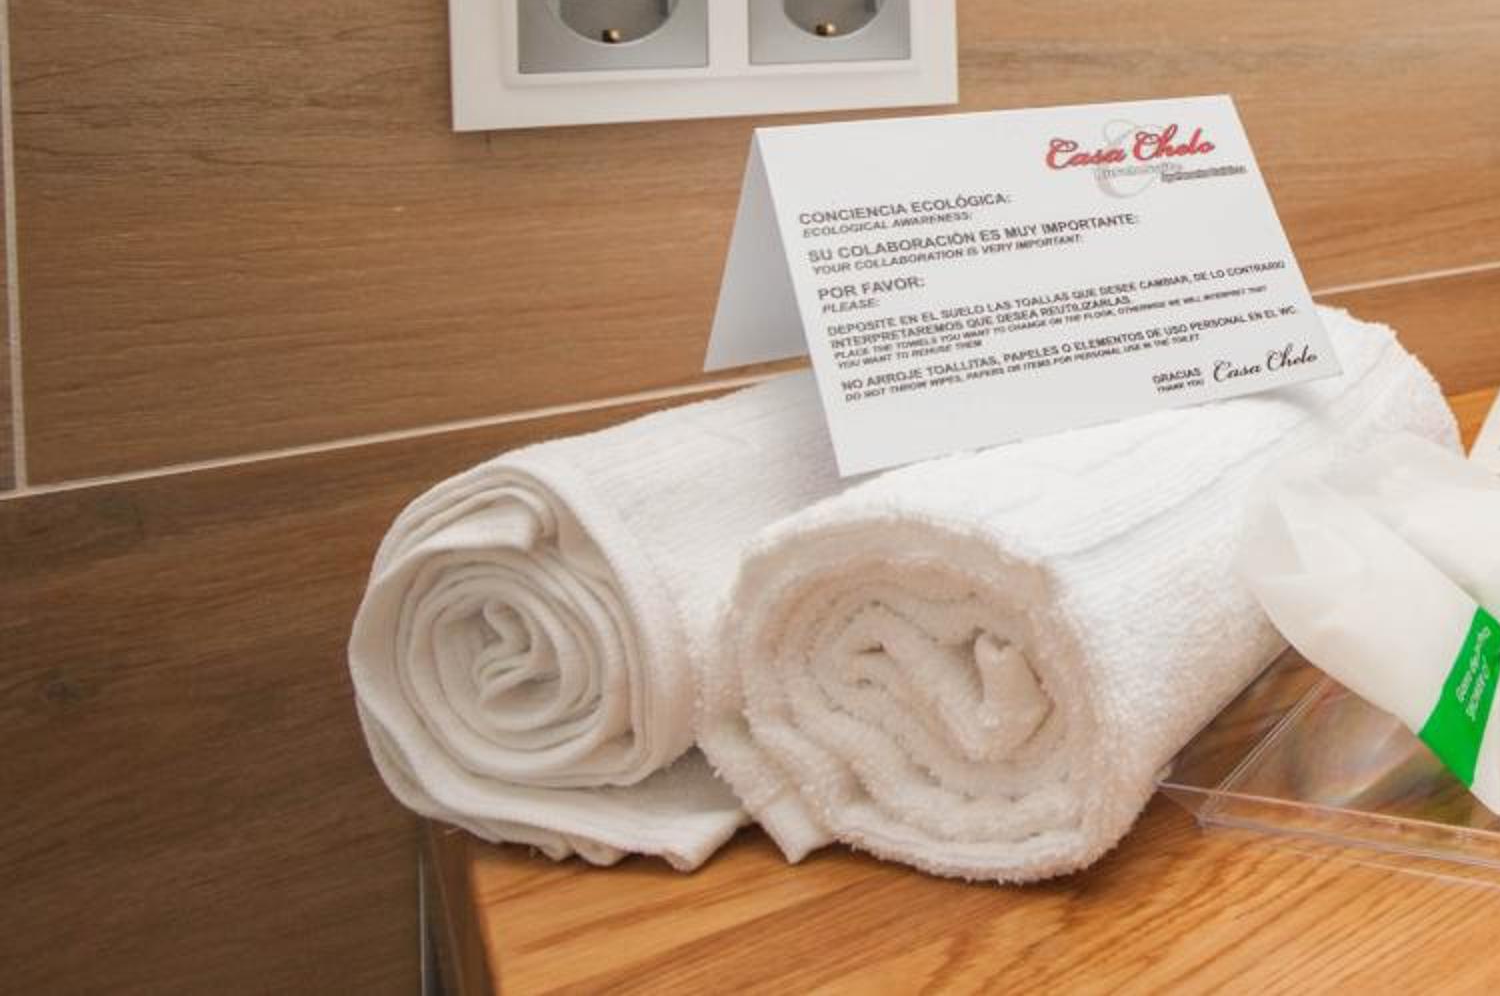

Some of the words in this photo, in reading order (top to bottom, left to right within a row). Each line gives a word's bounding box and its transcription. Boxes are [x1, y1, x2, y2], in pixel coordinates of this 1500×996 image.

[1046, 137, 1126, 169] Casa
[1133, 124, 1215, 161] Chelo
[799, 205, 907, 225] CONCIENCIA
[911, 192, 1012, 214] ECOLÓGICA:
[803, 221, 887, 238] ECOLOGICAL
[892, 211, 973, 229] AWARENESS:
[808, 249, 833, 263] SU
[837, 231, 976, 259] COLABORACIÓN
[980, 229, 1001, 242] ES
[1004, 224, 1037, 239] MUY
[1041, 213, 1138, 234] IMPORTANTE:
[813, 262, 850, 276] YOUR
[854, 249, 963, 271] COLLABORATION
[967, 245, 979, 255] IS
[981, 242, 1013, 254] VERY
[817, 285, 856, 300] POR
[861, 275, 925, 294] FAVOR:
[822, 298, 880, 313] PLEASE:
[827, 317, 897, 336] DEPOSITE
[900, 314, 918, 324] EN
[921, 311, 939, 321] EL
[942, 305, 985, 319] SUELO
[987, 301, 1012, 312] LAS
[1015, 292, 1070, 308] TOALLAS
[1072, 289, 1097, 299] QUE
[1100, 282, 1136, 295] DESEE
[1139, 275, 1192, 290] CAMBIAR,
[1193, 271, 1209, 281] DE
[1210, 269, 1225, 279] LO
[1227, 260, 1285, 277] CONTRARIO
[830, 320, 964, 349] INTERPRETAREMOS
[966, 315, 994, 328] QUE
[996, 311, 1038, 324] DESEA
[834, 347, 869, 360] PLACE
[872, 344, 892, 353] THE
[896, 337, 937, 350] TOWELS
[940, 333, 961, 343] YOU
[962, 328, 990, 339] WANT
[993, 324, 1007, 333] TO
[1007, 319, 1047, 332] CHANGE
[1050, 317, 1063, 325] ON
[1064, 313, 1080, 322] THE
[838, 358, 861, 369] YOU
[863, 354, 892, 365] WANT
[896, 351, 909, 359] TO
[955, 339, 982, 350] THEM
[841, 378, 863, 391] NO
[867, 368, 923, 387] ARROJE
[926, 354, 1000, 375] TOALLITAS,
[1003, 345, 1058, 363] PAPELES
[1061, 343, 1071, 353] O
[1074, 331, 1145, 351] ELEMENTOS
[1146, 327, 1162, 339] DE
[1164, 323, 1189, 336] USO
[1190, 314, 1248, 331] PERSONAL
[1249, 311, 1263, 321] EN
[1264, 308, 1278, 318] EL
[1152, 367, 1202, 384] GRACIAS
[1213, 360, 1262, 382] Casa
[1267, 343, 1318, 371] Chelo
[845, 392, 862, 402] DO
[864, 387, 886, 398] NOT
[890, 381, 928, 394] THROW
[966, 367, 1005, 380] PAPERS
[1006, 364, 1022, 373] OR
[1023, 360, 1050, 371] ITEMS
[1053, 356, 1073, 365] FOR
[1074, 348, 1121, 361] PERSONAL
[1123, 344, 1140, 353] USE
[1153, 337, 1171, 347] THE
[1157, 382, 1185, 393] THANK
[1187, 378, 1205, 388] YOU
